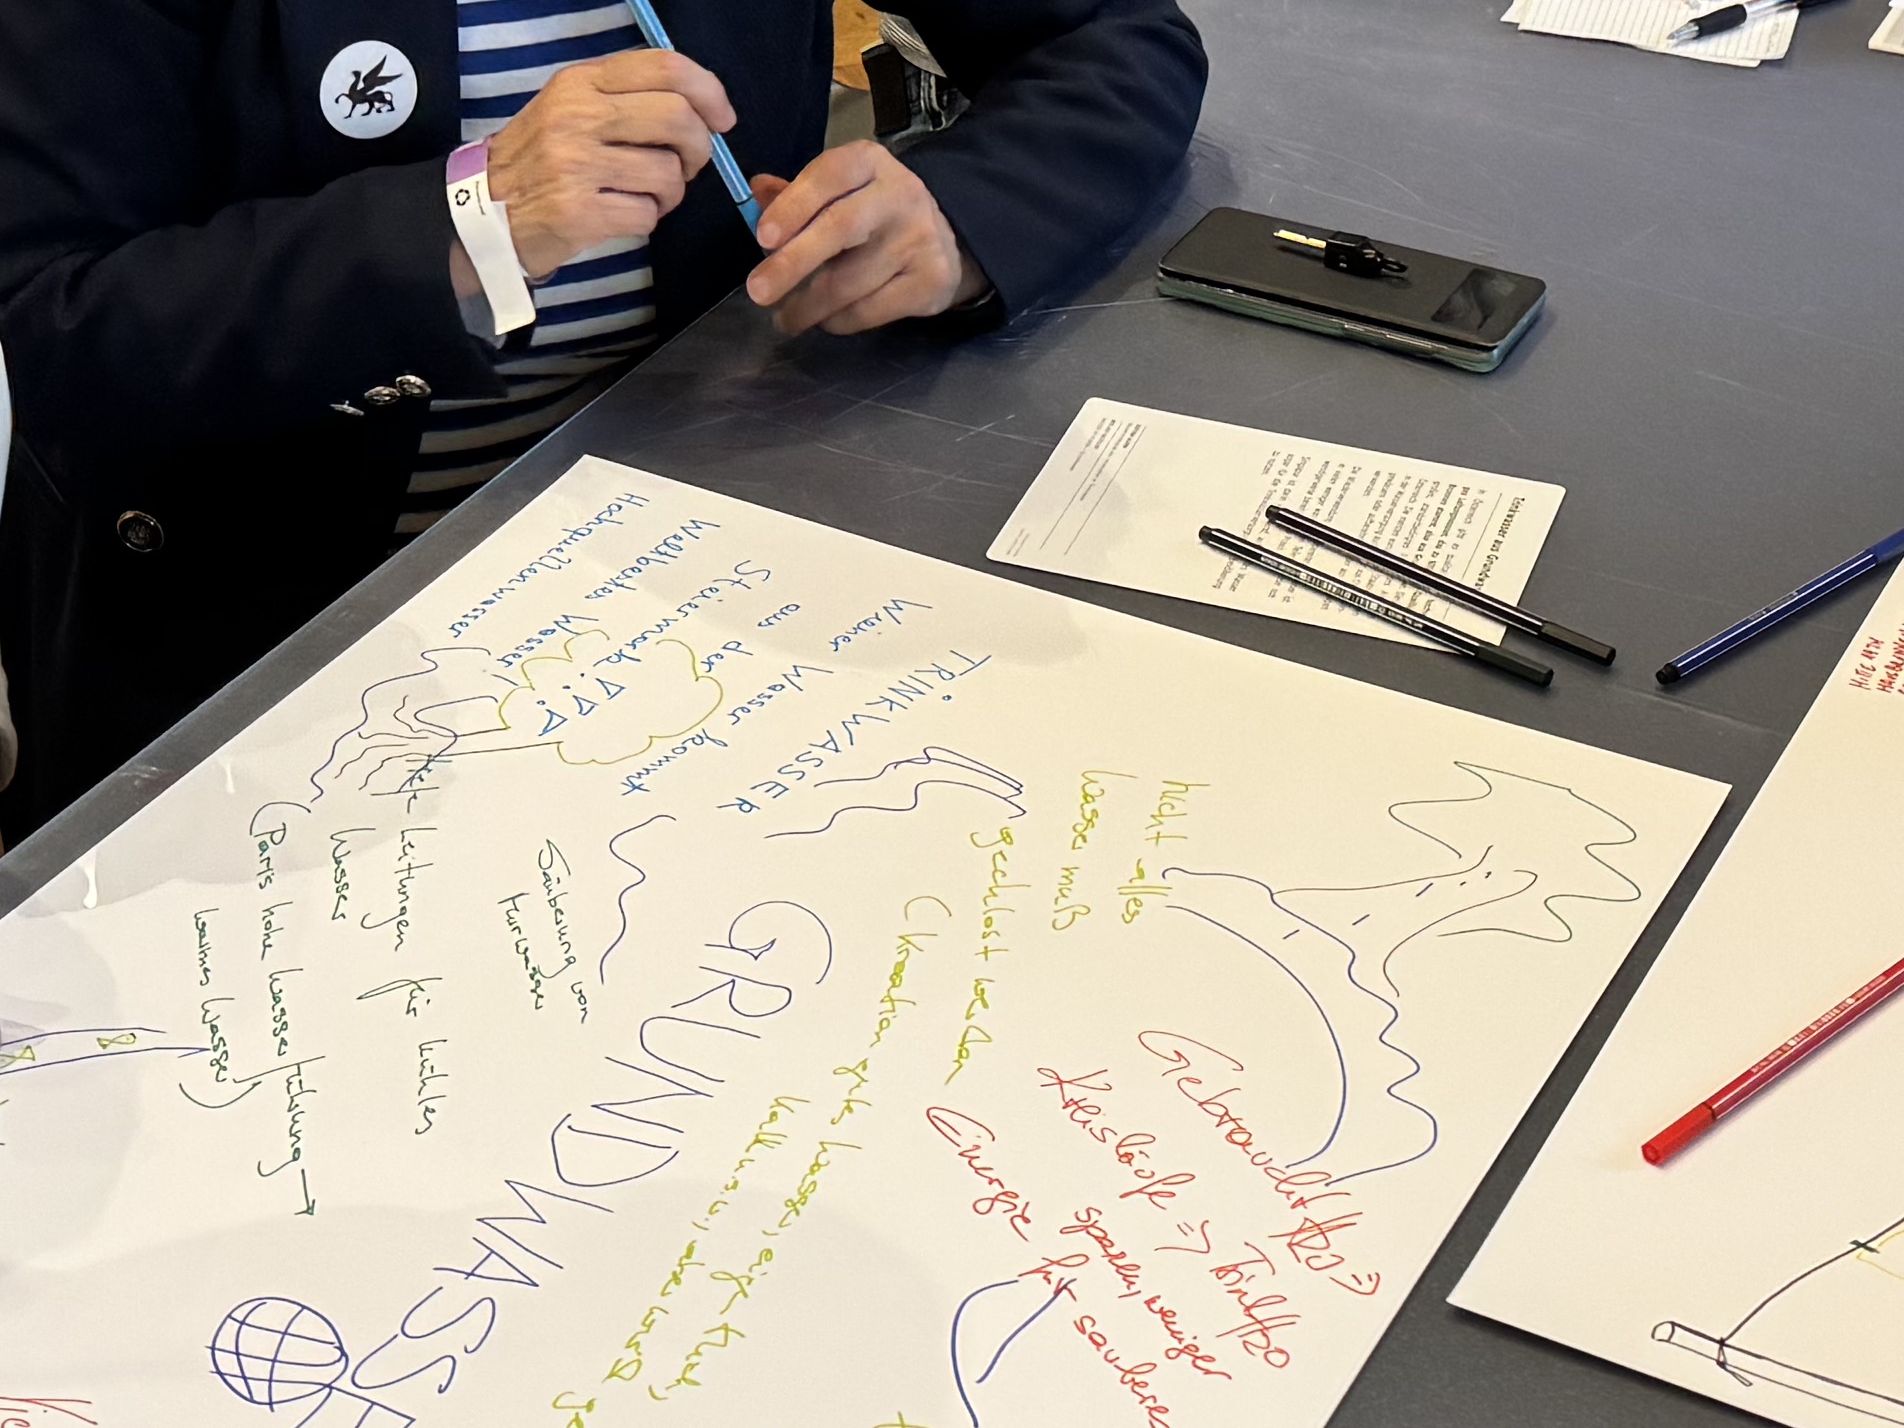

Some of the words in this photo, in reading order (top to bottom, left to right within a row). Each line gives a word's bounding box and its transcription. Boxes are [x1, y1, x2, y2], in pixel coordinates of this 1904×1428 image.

[1498, 497, 1525, 538] Trinkwasser
[758, 604, 800, 627] aus
[829, 599, 932, 652] Wiener
[692, 641, 753, 673] der
[728, 665, 833, 725] Wasser
[717, 650, 991, 813] TRINKWASSER
[621, 728, 728, 795] kommt
